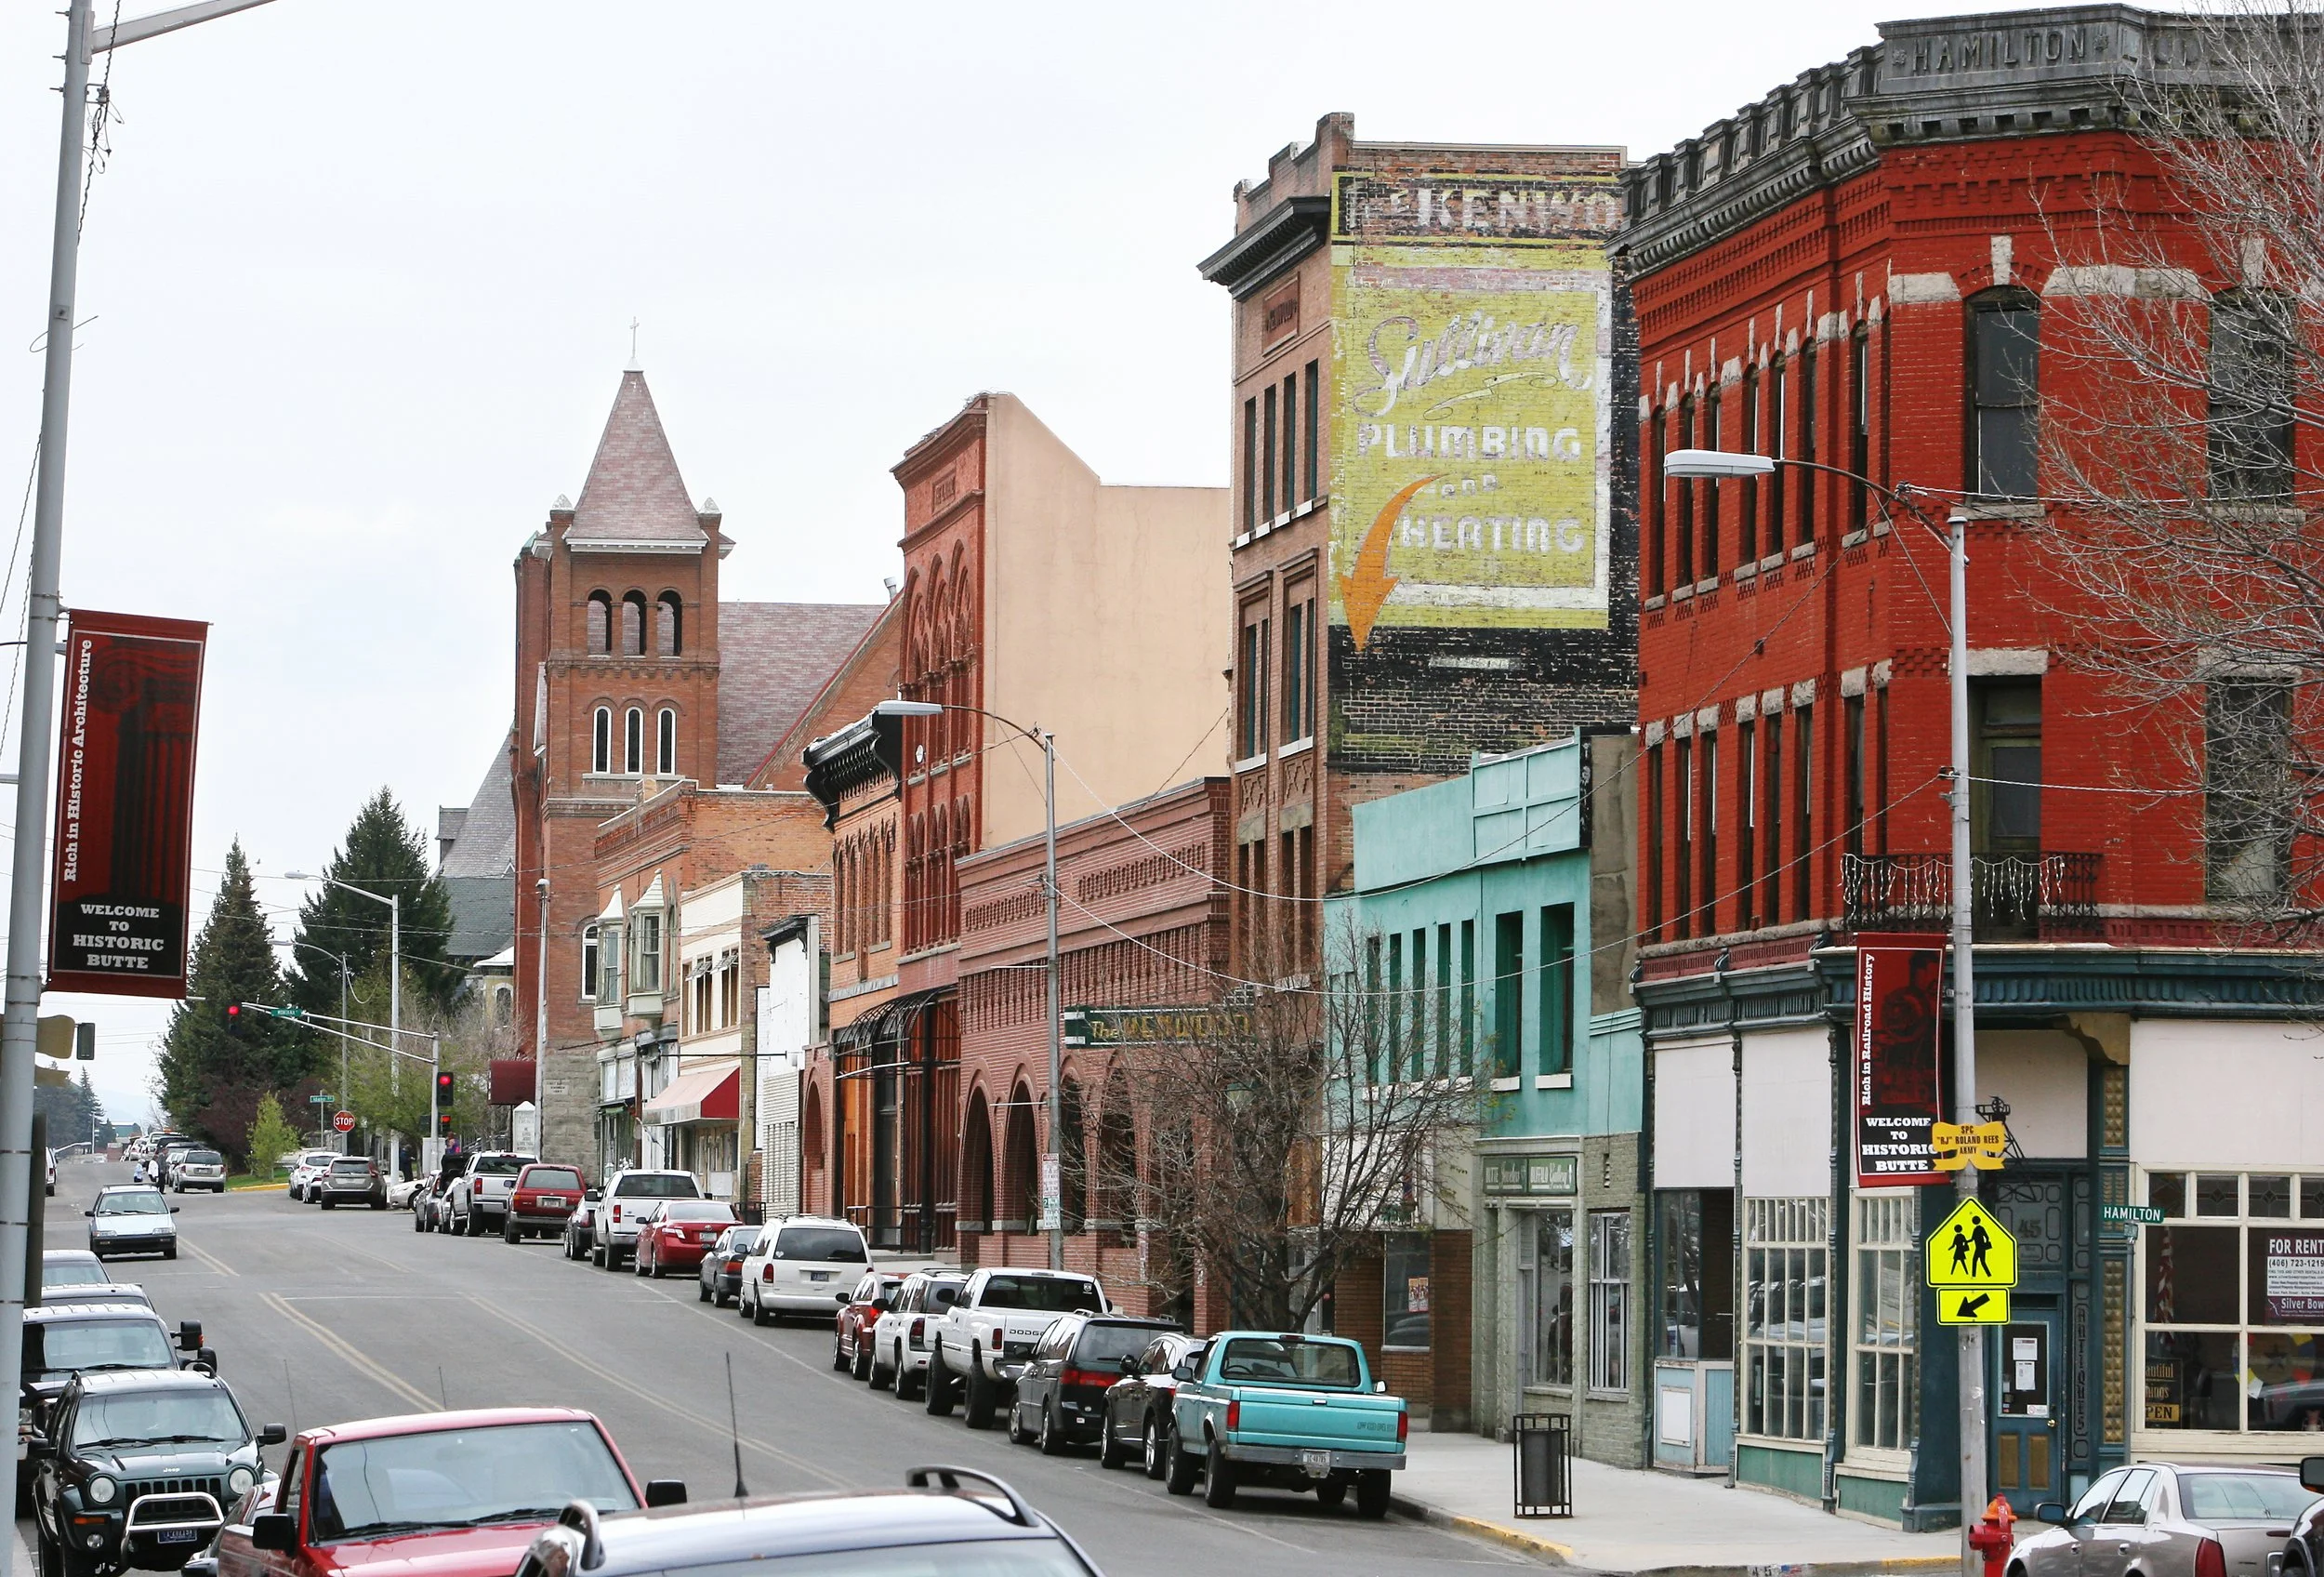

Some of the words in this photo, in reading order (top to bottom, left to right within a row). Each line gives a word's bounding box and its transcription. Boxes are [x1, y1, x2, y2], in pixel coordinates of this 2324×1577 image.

[1912, 27, 2086, 73] HAMILTON
[1353, 309, 1592, 417] Sullivan
[1400, 515, 1586, 553] HEATING
[74, 639, 92, 748] Architecture
[68, 749, 84, 820] Historic
[66, 822, 79, 840] in
[63, 842, 78, 882] Rich
[80, 904, 160, 919] WELCOME
[109, 921, 130, 932] TO
[73, 934, 165, 951] HISTORIC
[86, 953, 149, 969] BUTTE
[1864, 953, 1875, 1002] History
[1862, 1003, 1873, 1061] Railroad
[1862, 1061, 1871, 1074] in
[1862, 1075, 1871, 1106] Rich
[336, 1117, 354, 1126] STOP
[1866, 1117, 1932, 1127] WELCOME
[1890, 1131, 1908, 1140] TO
[1961, 1125, 1974, 1134] SPC
[1875, 1160, 1929, 1173] BUTTE
[2104, 1206, 2161, 1221] HAMILTON
[2269, 1239, 2292, 1254] FOR
[2295, 1239, 2324, 1254] RENT
[2269, 1259, 2288, 1268] (406)
[2281, 1297, 2305, 1309] Silver
[2307, 1298, 2324, 1309] Bow
[2146, 1363, 2173, 1378] autiful
[2146, 1405, 2172, 1419] PEN
[1356, 1422, 1395, 1432] FORD
